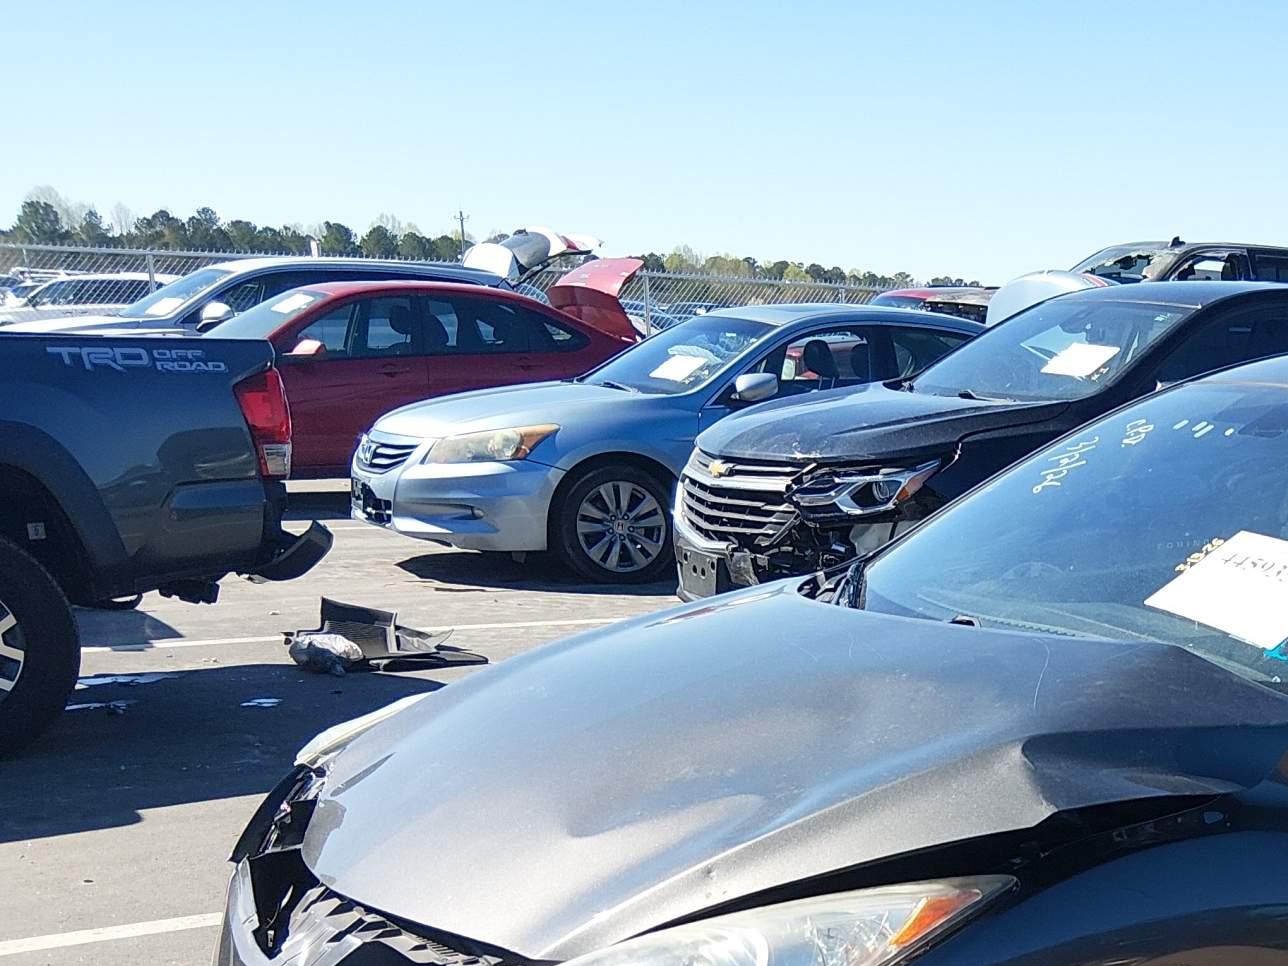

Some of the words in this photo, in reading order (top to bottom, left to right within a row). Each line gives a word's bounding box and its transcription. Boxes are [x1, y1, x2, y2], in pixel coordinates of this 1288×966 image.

[46, 346, 150, 372] TRD
[153, 349, 203, 359] OFF
[156, 361, 229, 372] ROAD
